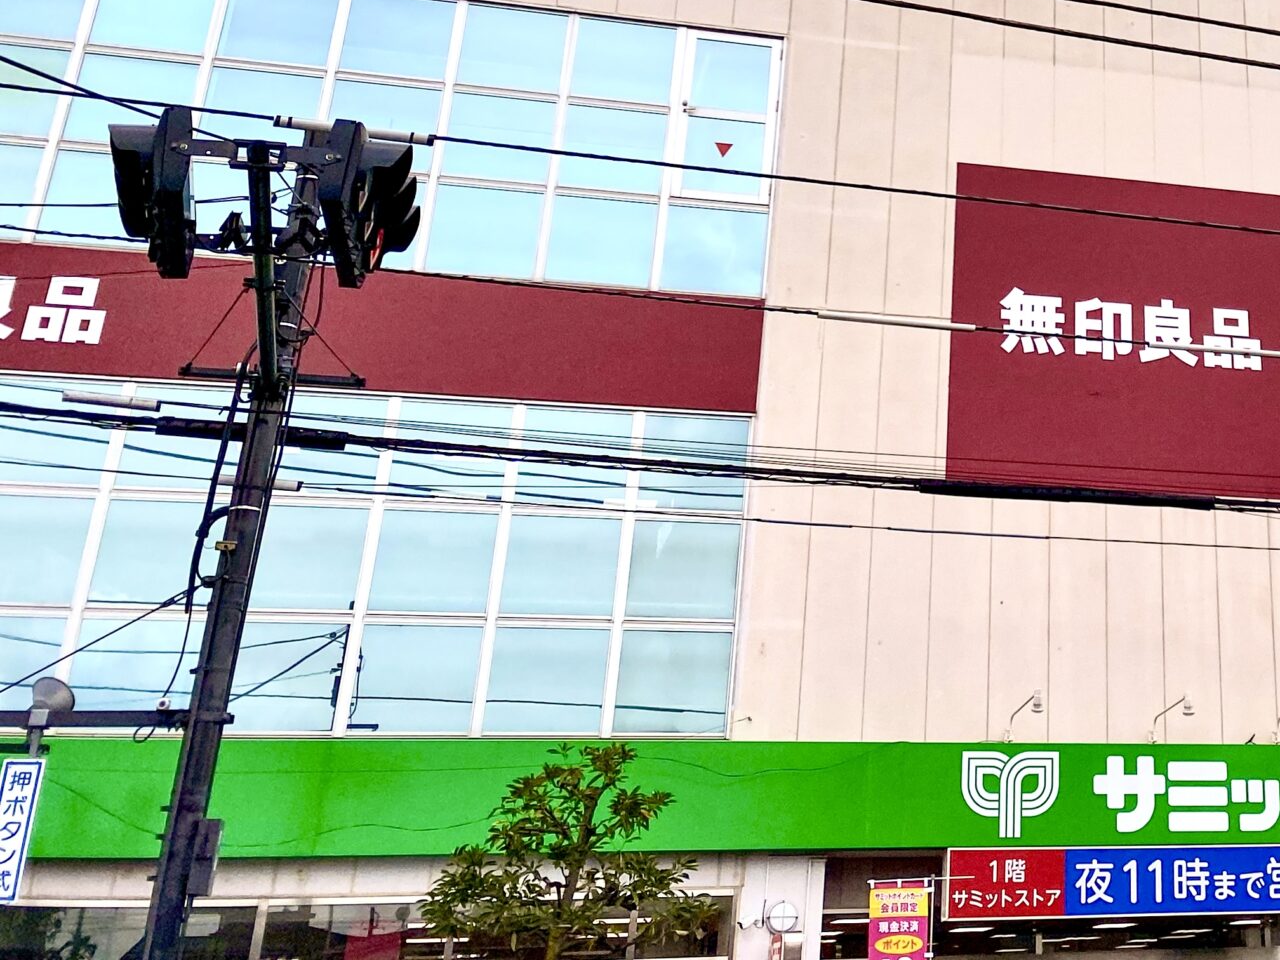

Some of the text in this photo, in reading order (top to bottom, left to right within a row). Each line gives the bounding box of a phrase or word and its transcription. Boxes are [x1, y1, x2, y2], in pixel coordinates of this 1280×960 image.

[1000, 286, 1263, 372] 無印良品
[989, 859, 1026, 883] 1階
[880, 902, 918, 913] 会員限定
[952, 888, 1061, 908] サミットストア
[882, 939, 918, 950] ポイント
